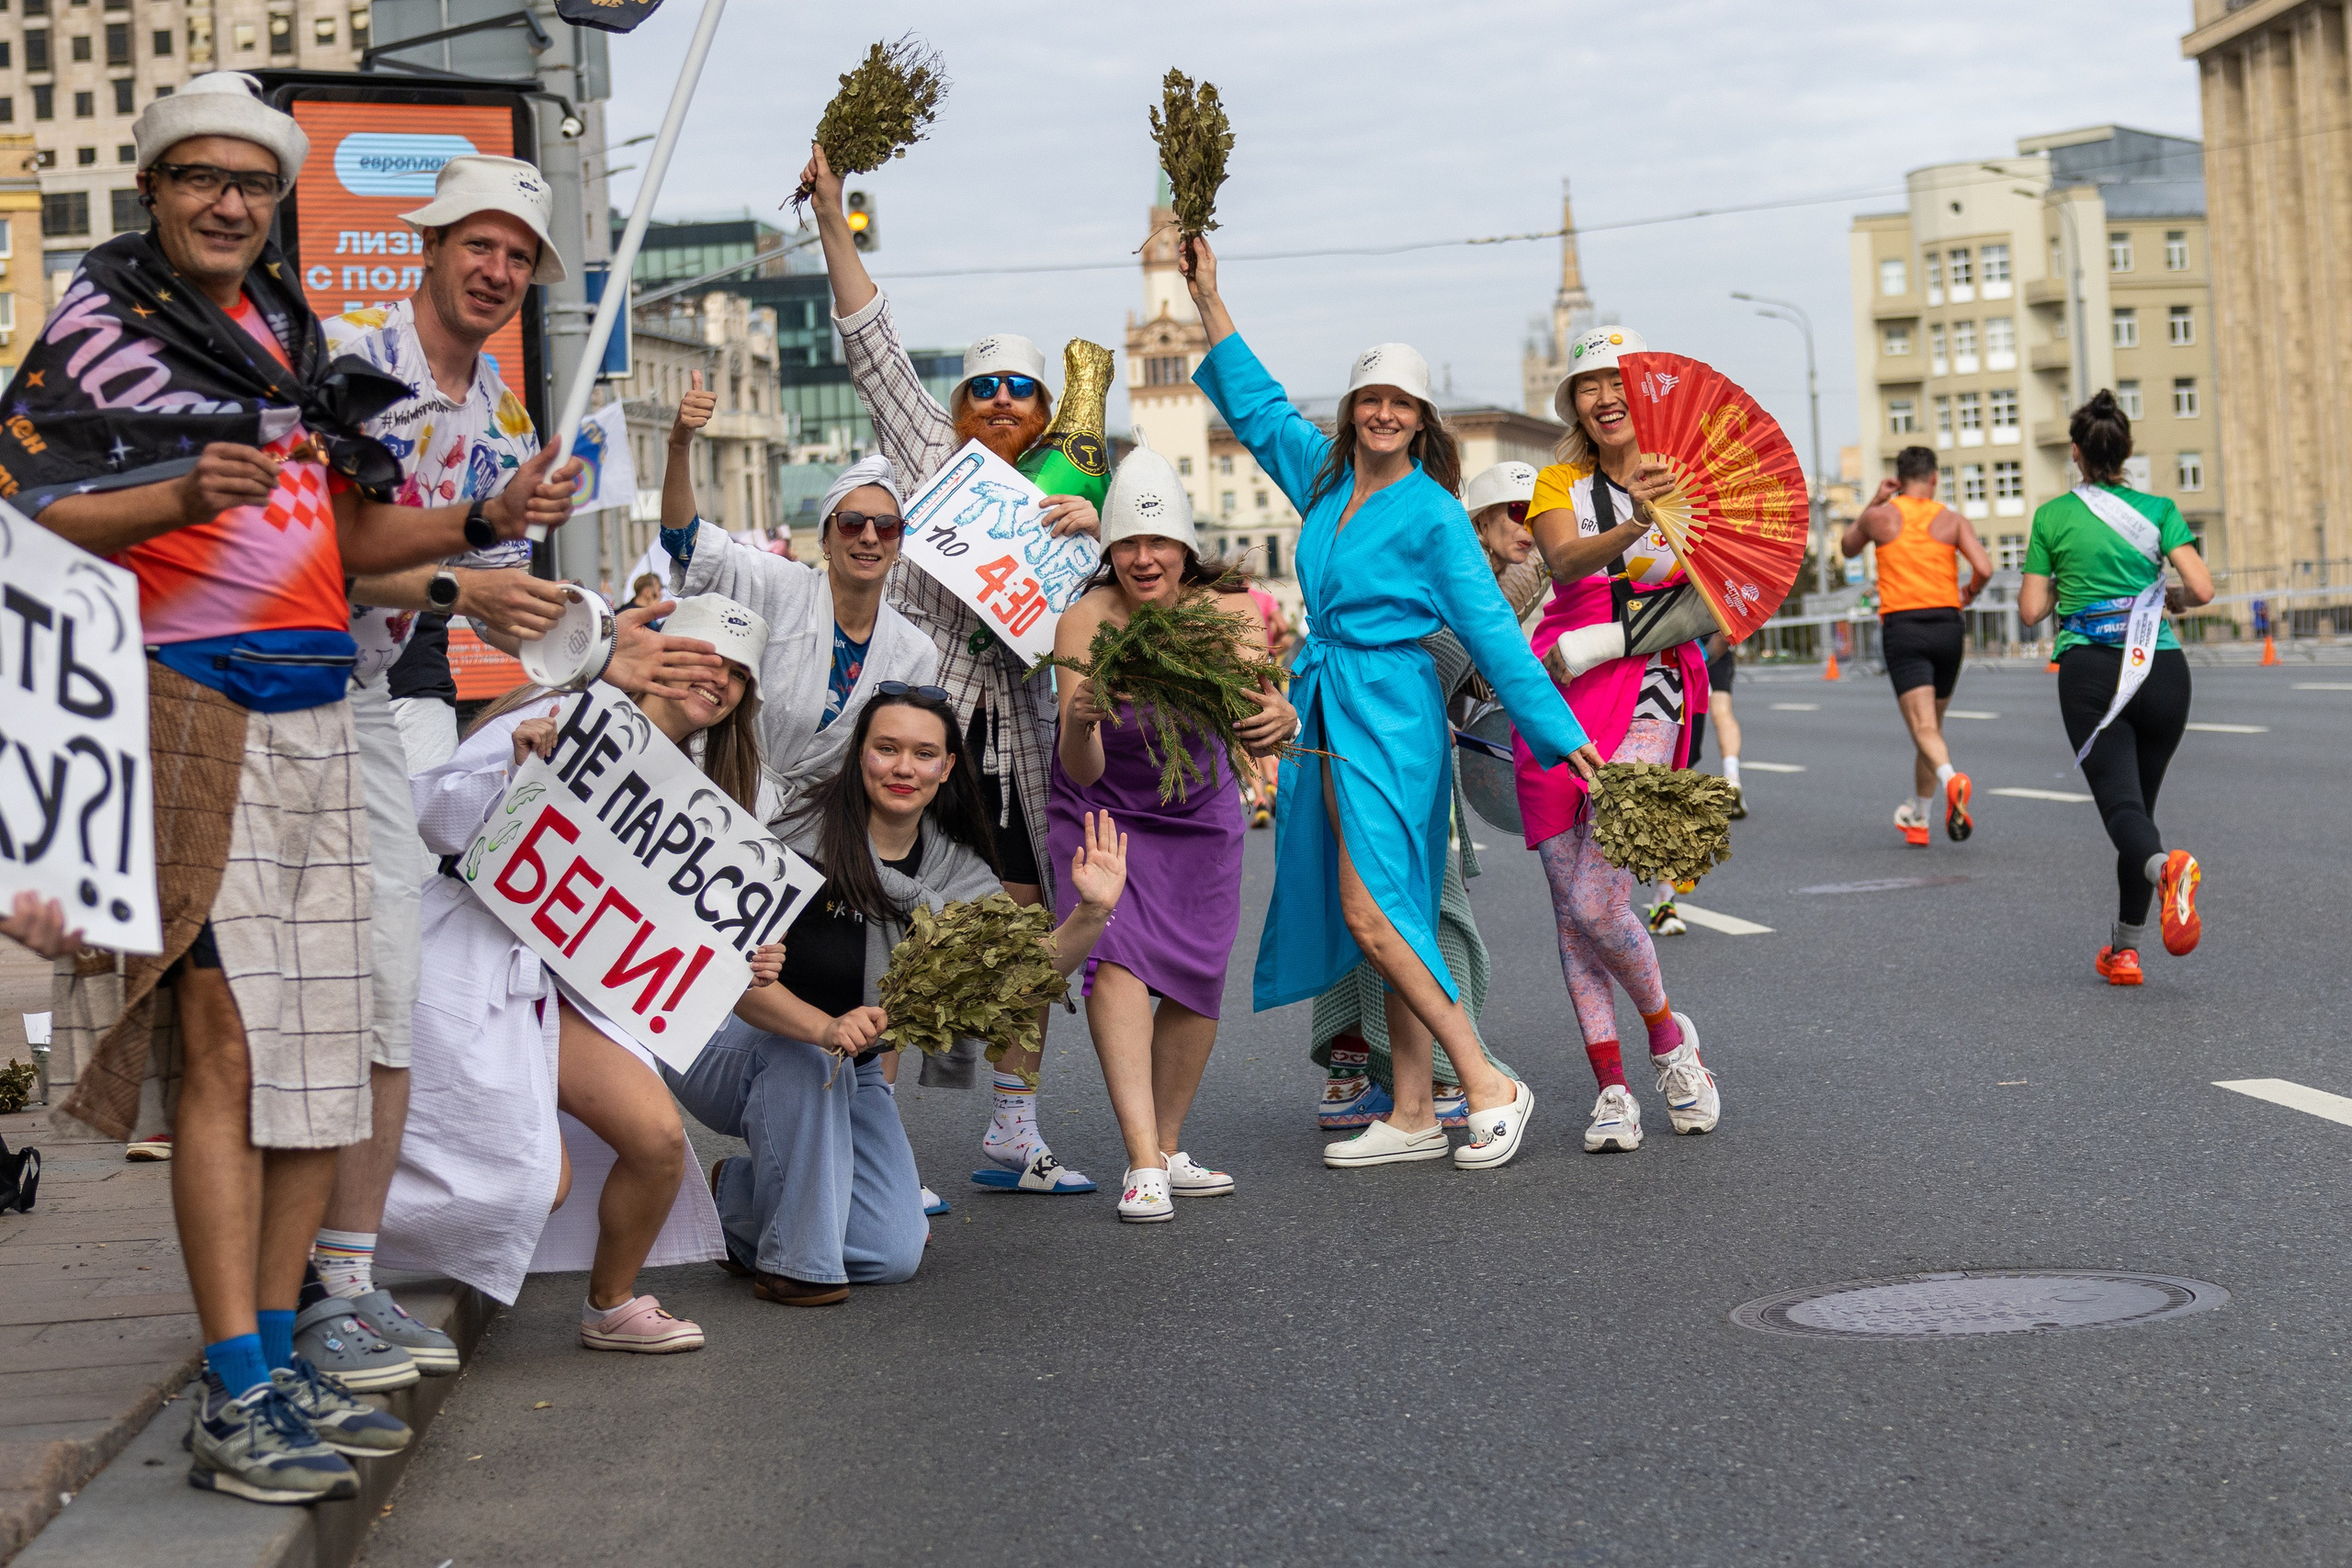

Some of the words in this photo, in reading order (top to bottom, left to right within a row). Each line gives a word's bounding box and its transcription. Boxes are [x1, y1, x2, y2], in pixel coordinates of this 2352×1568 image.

[306, 265, 333, 291] С
[3, 581, 116, 719] ТЬ
[975, 554, 1048, 637] 4:30
[1724, 580, 1748, 616] ФЕСТИВАЛЬ
[545, 691, 623, 804] НЕ
[597, 770, 802, 963] ПАРЬСЯ!
[493, 804, 716, 1034] БЕГИ!
